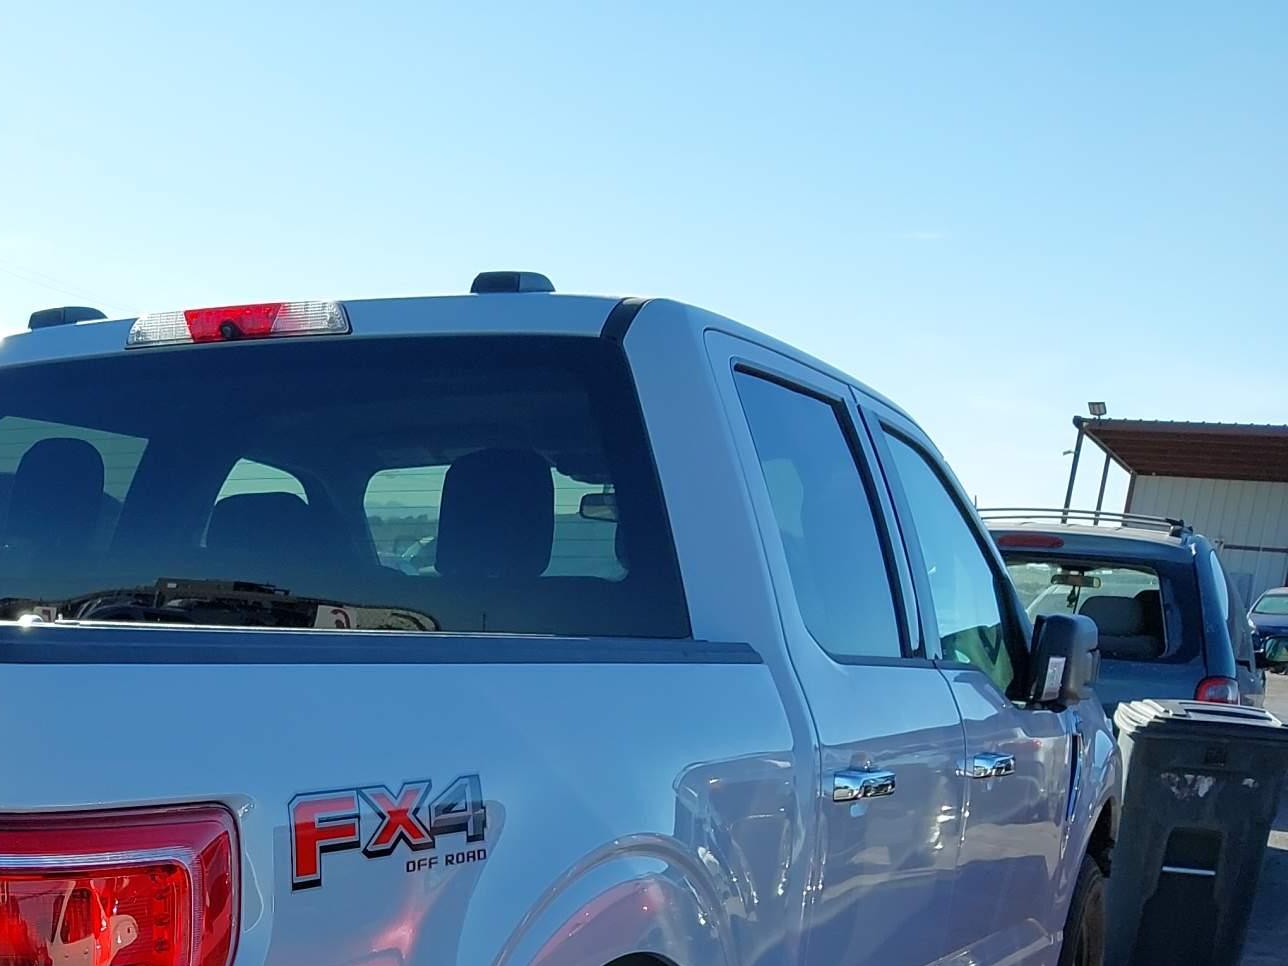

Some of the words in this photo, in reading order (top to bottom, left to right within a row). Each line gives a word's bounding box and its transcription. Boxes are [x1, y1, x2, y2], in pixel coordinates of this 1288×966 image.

[288, 774, 487, 891] FX4
[406, 856, 439, 873] OFF
[444, 848, 488, 866] ROAD
